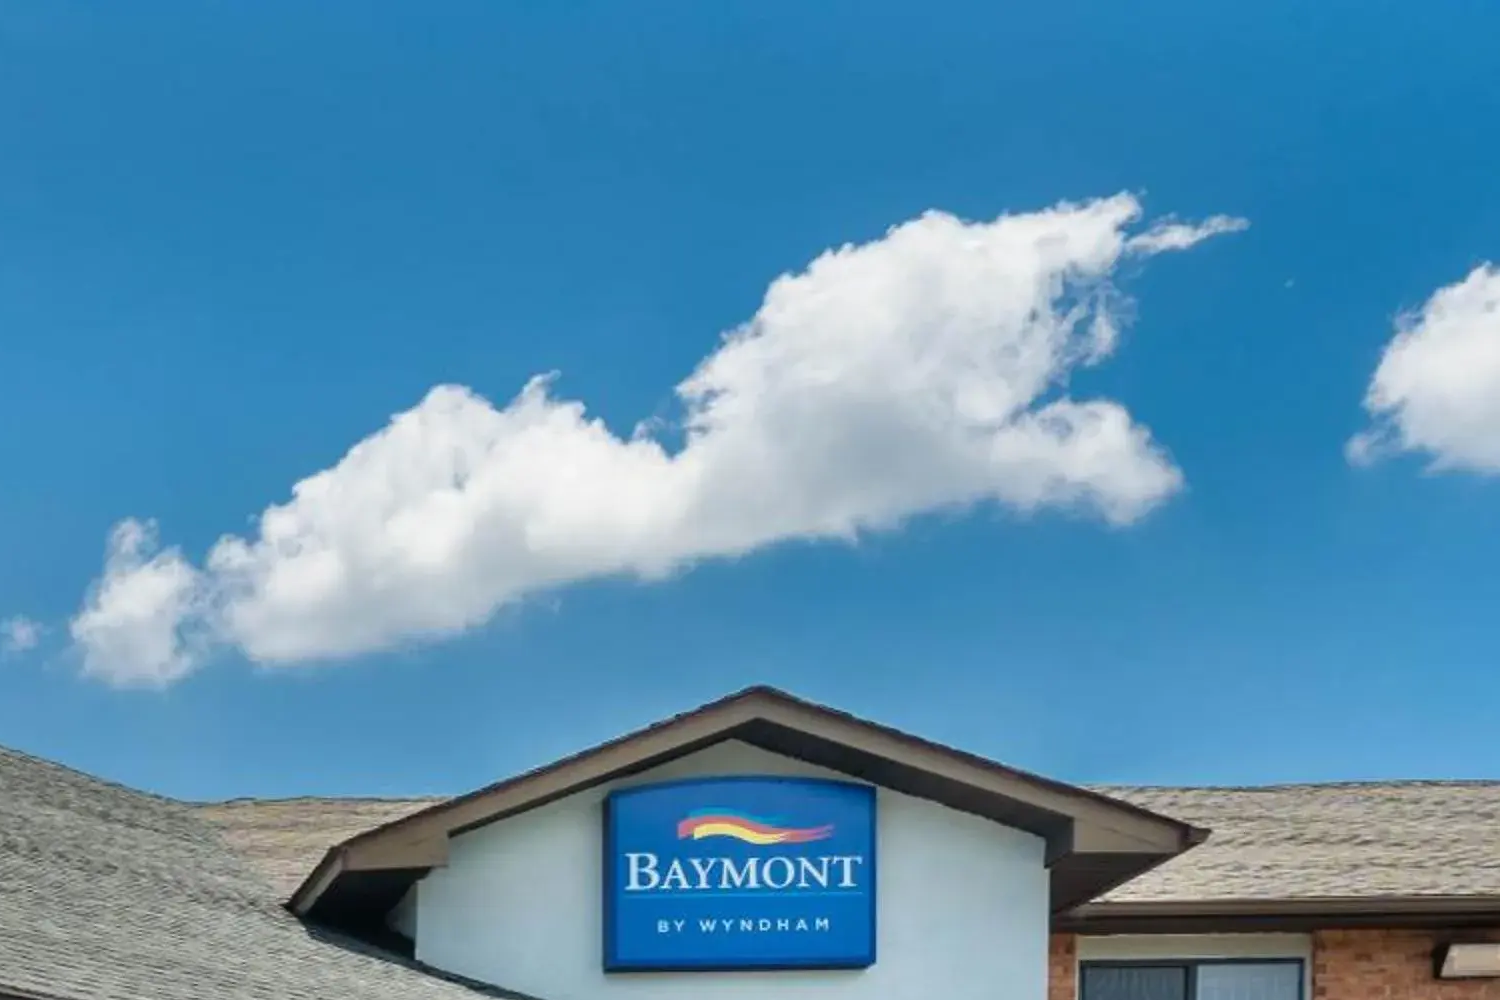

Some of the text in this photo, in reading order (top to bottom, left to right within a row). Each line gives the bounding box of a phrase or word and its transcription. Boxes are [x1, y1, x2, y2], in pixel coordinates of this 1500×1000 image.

[624, 853, 863, 891] BAYMONT
[657, 918, 830, 933] BY WYNDHAM
